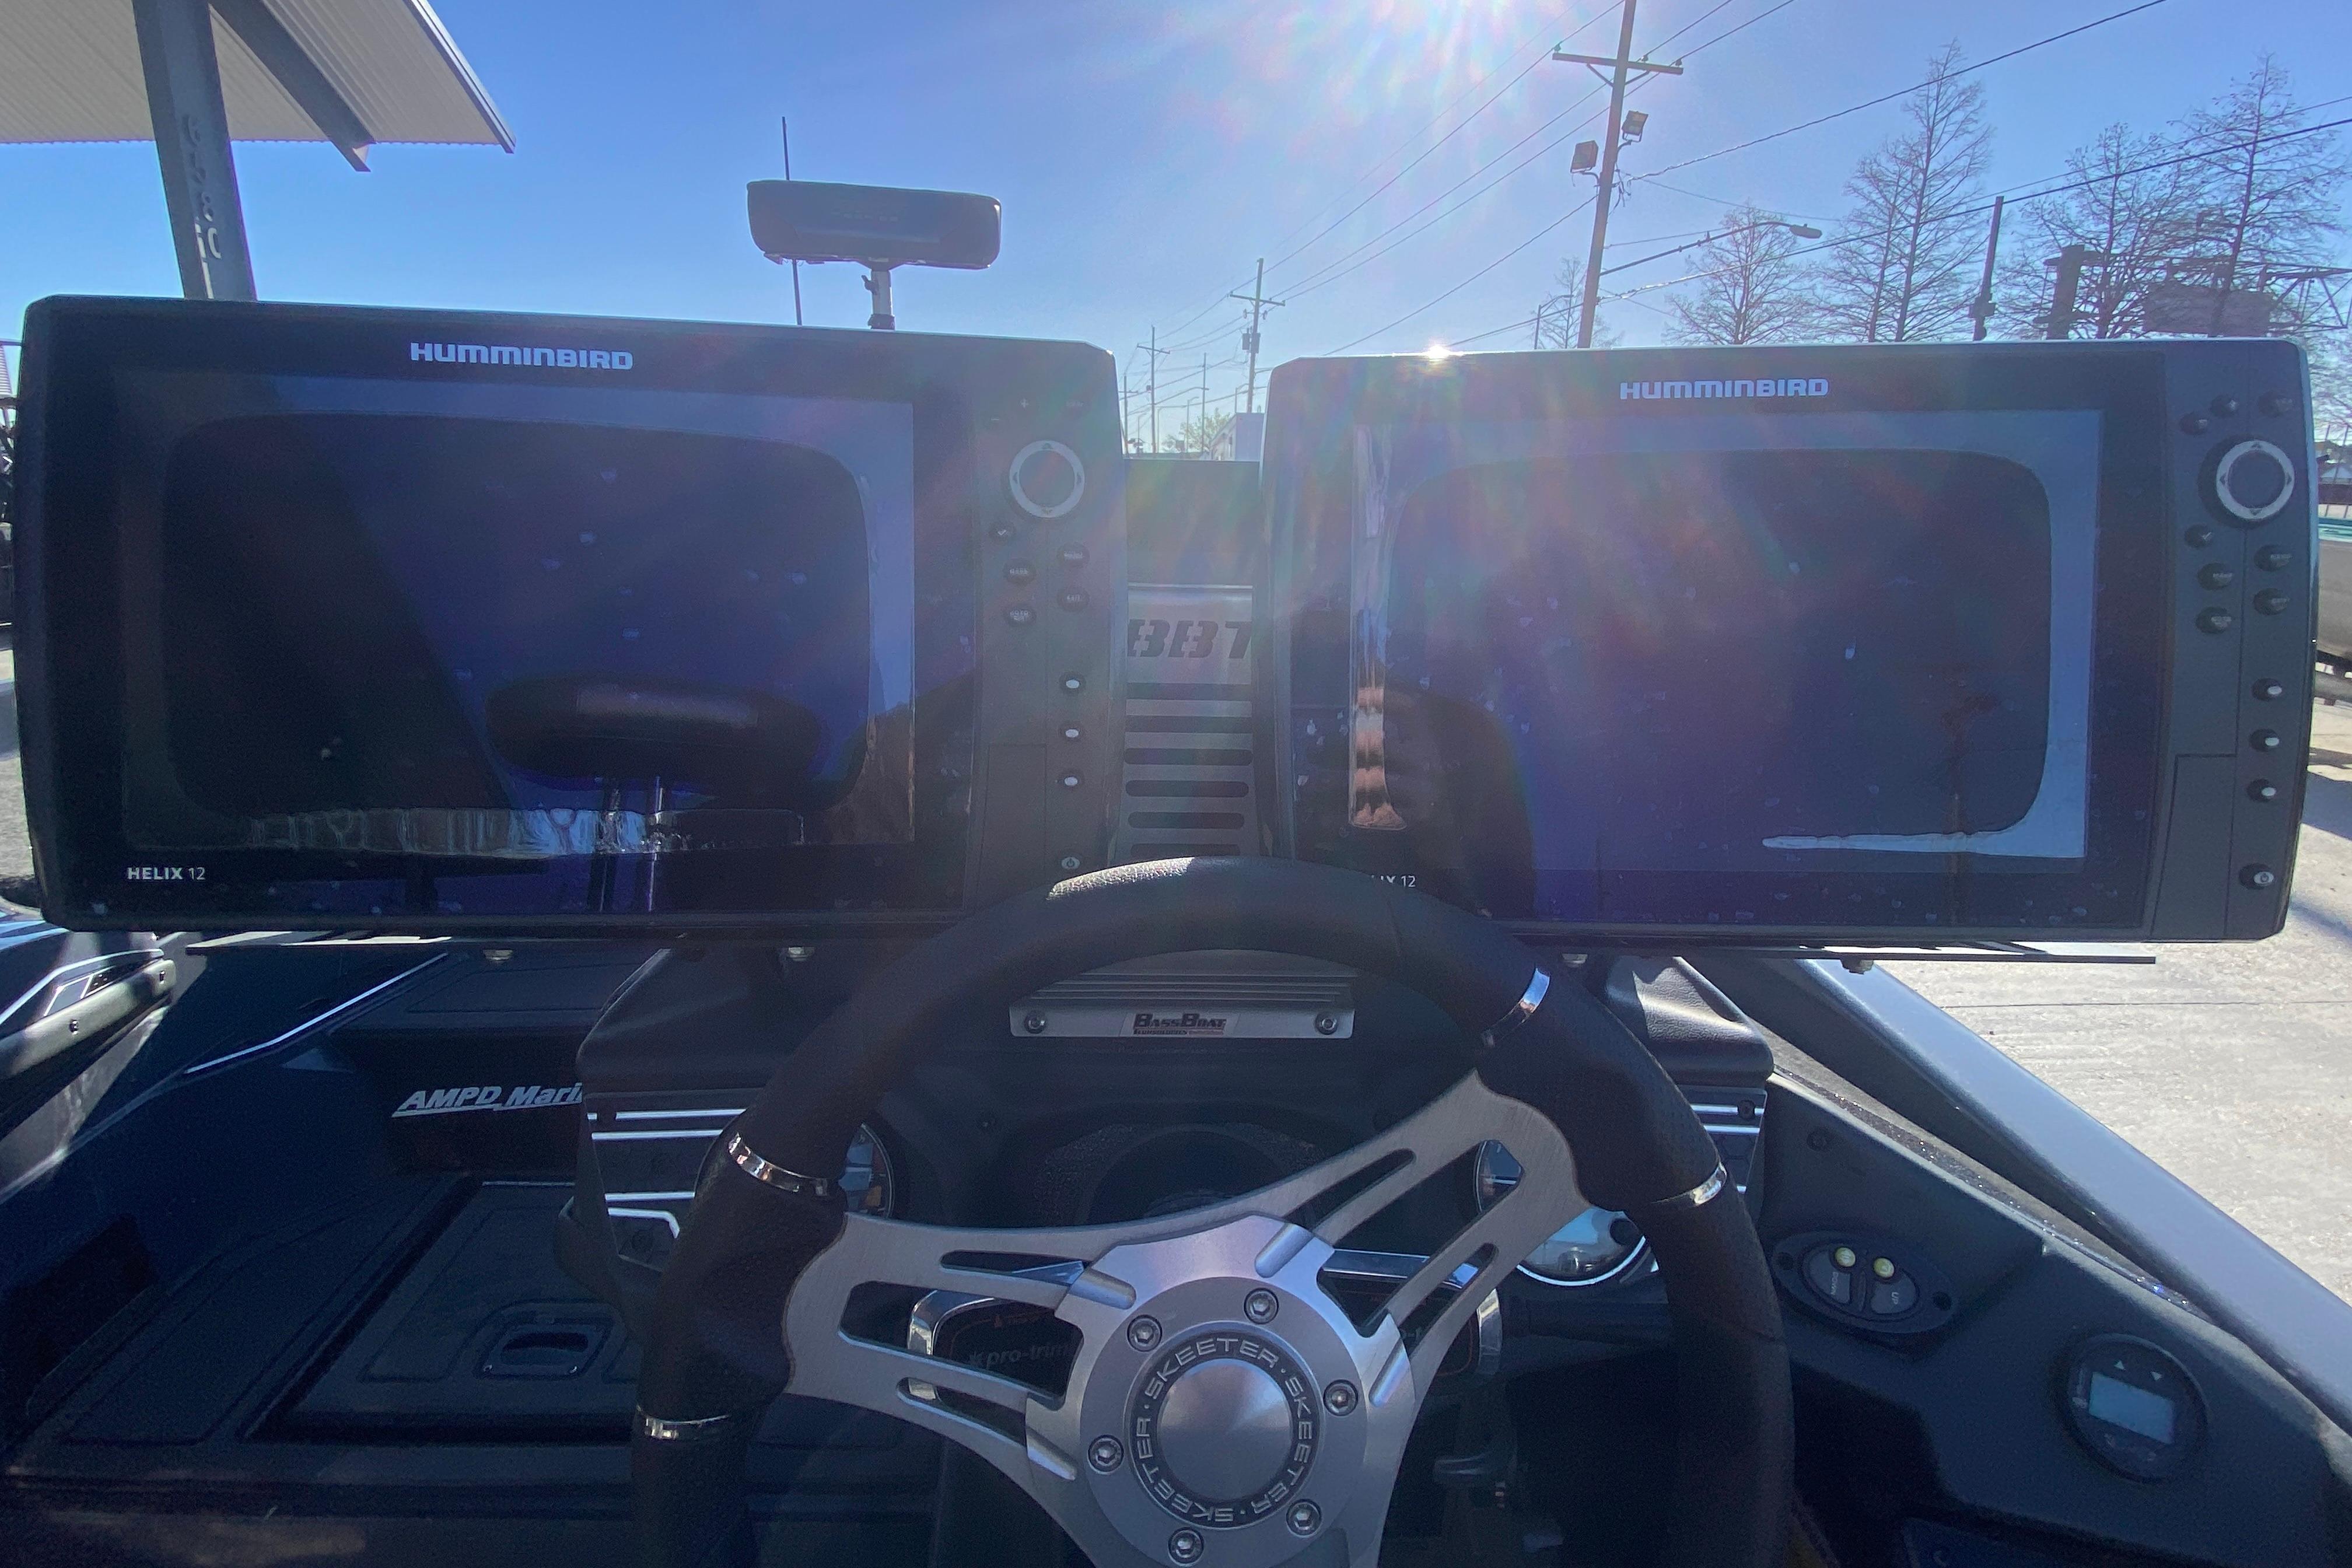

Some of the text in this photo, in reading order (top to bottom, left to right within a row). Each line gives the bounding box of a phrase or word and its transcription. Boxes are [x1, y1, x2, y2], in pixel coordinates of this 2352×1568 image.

[411, 342, 634, 370] HUMMINBIRD
[1620, 378, 1829, 399] HUMMINBIRD
[127, 867, 205, 880] HELIX 12
[1401, 875, 1416, 887] 12
[392, 1086, 502, 1115] AMPD
[1891, 1292, 1899, 1304] UP
[1136, 1338, 1312, 1522] SKEETER SKEETER SKEETER
